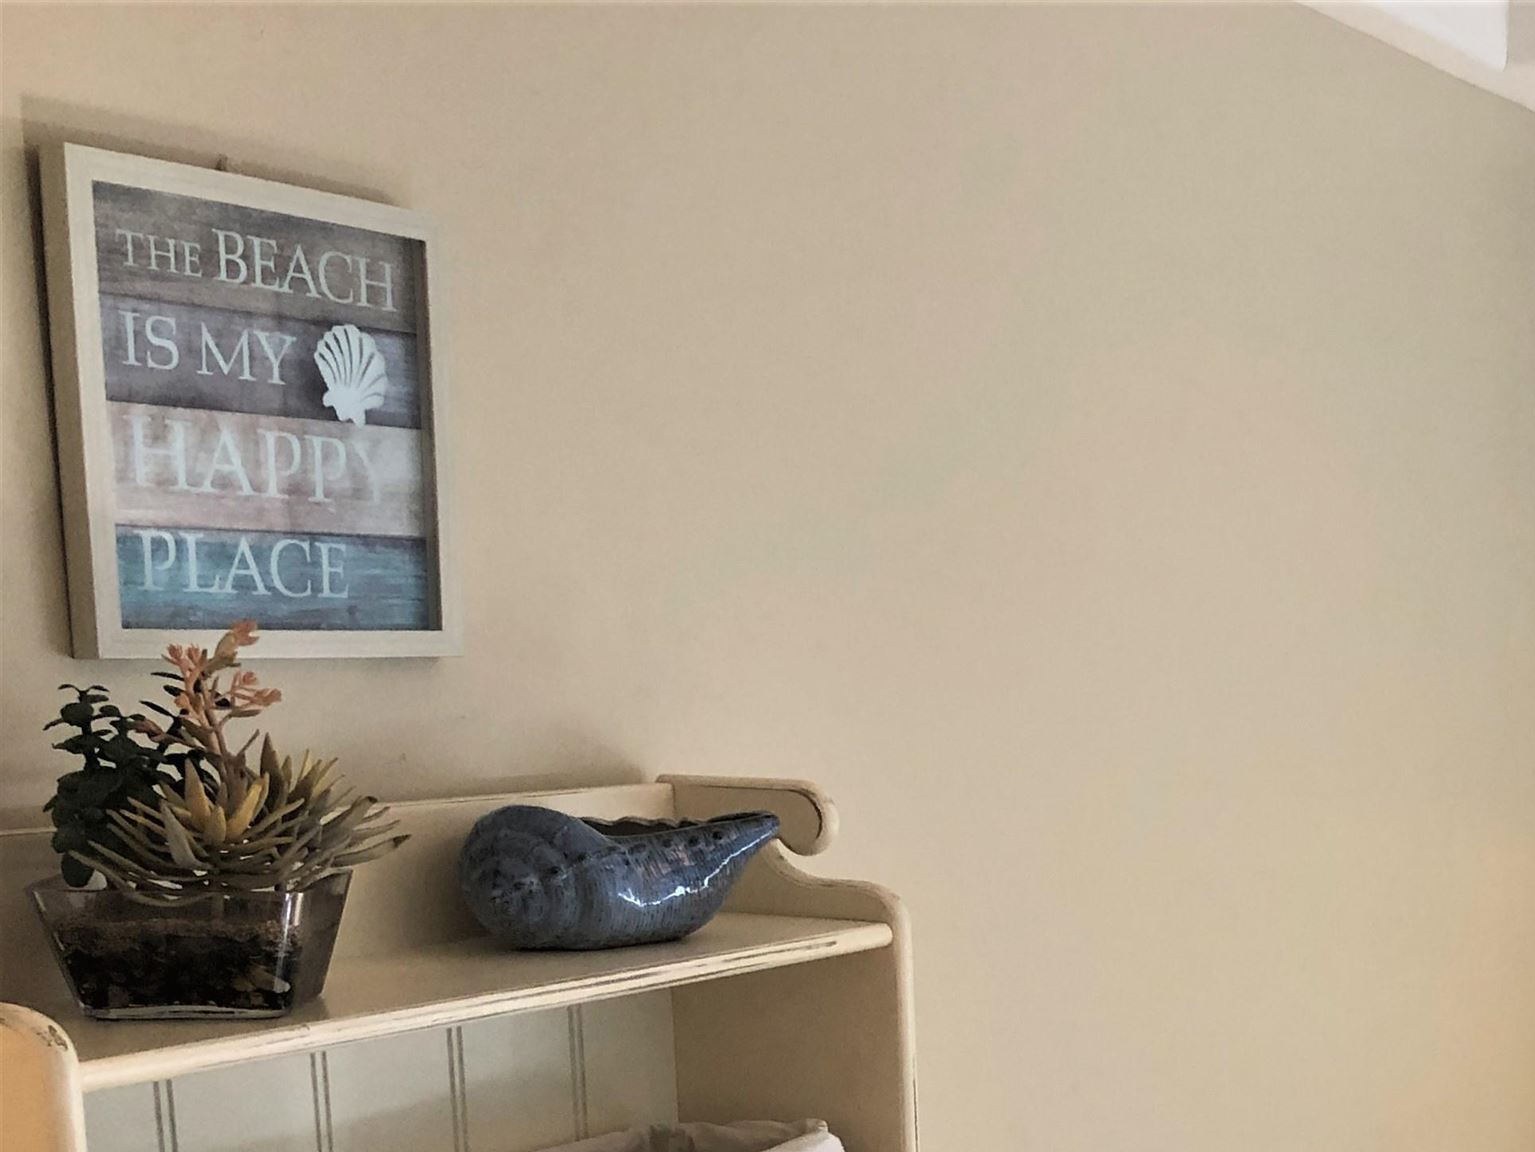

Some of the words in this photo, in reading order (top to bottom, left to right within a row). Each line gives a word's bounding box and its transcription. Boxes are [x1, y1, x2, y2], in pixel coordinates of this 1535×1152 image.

[115, 230, 202, 277] THE
[212, 228, 397, 312] BEACH
[121, 311, 180, 370] IS
[197, 322, 296, 385] MY
[135, 530, 350, 598] PLACE
